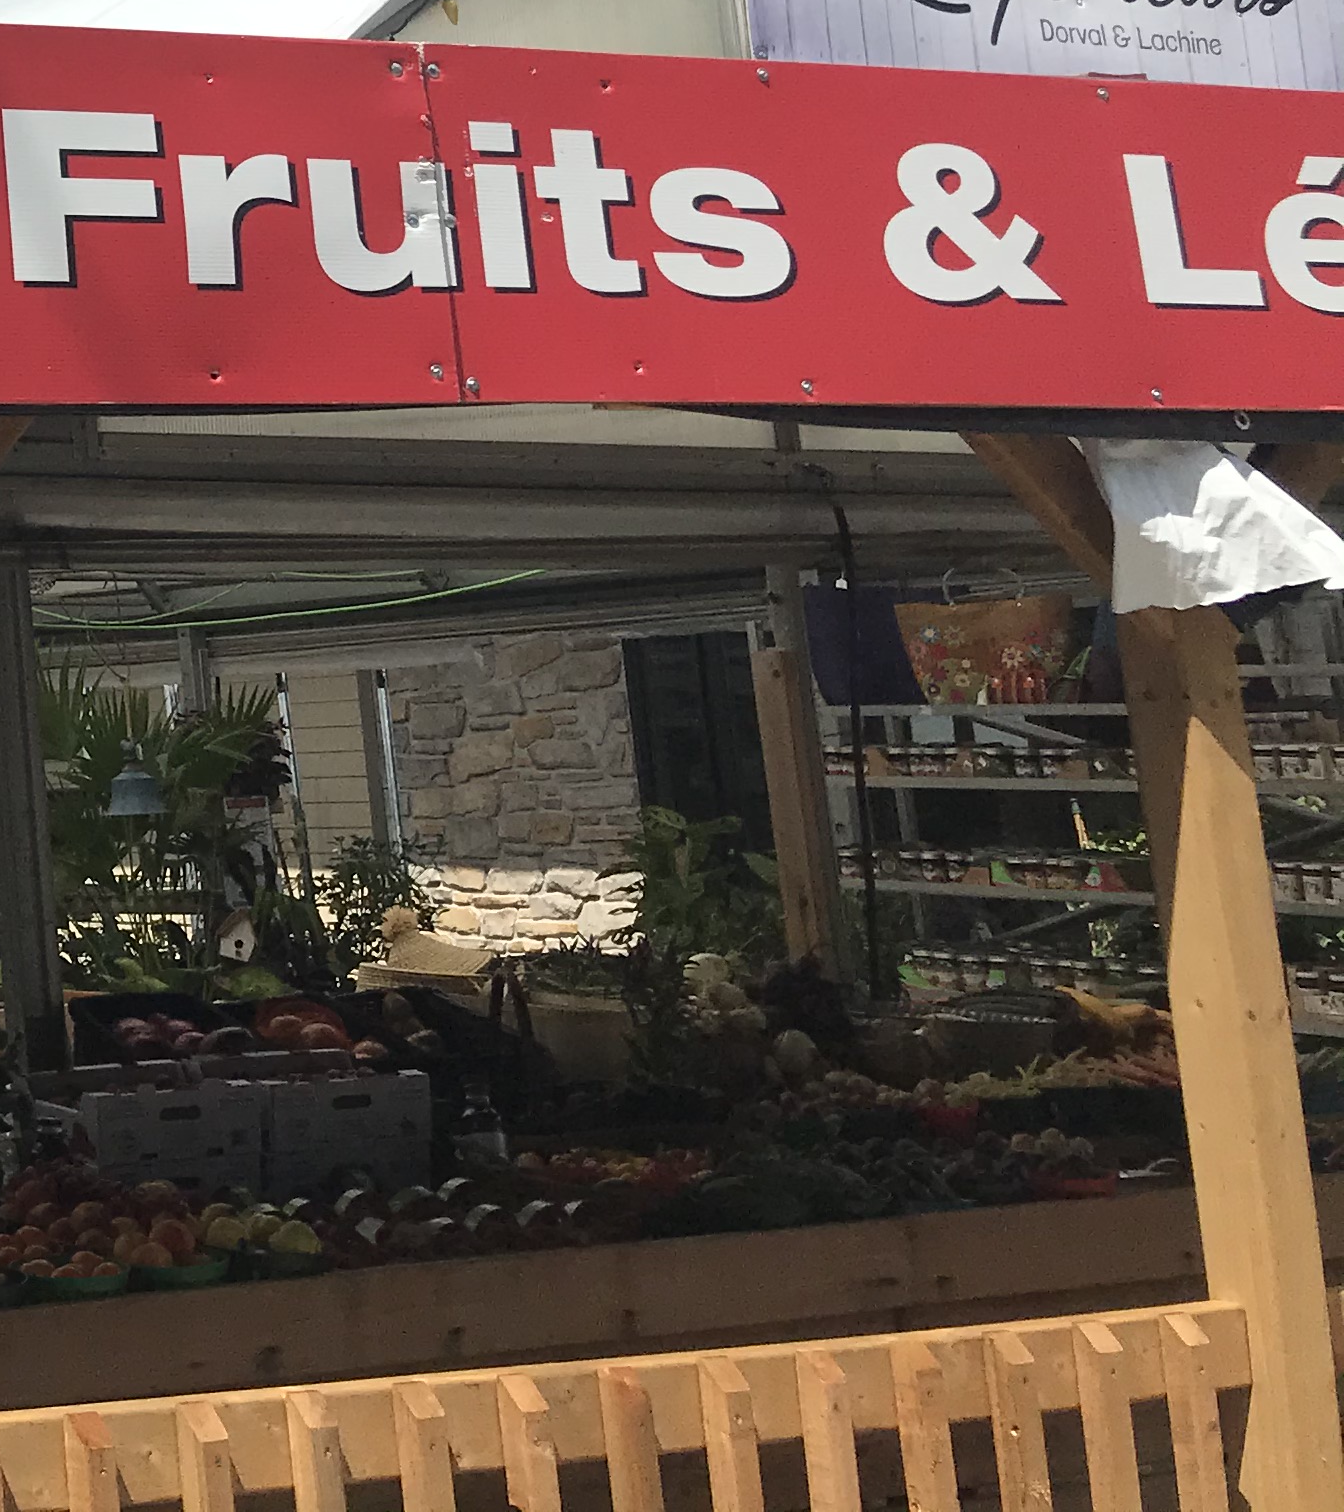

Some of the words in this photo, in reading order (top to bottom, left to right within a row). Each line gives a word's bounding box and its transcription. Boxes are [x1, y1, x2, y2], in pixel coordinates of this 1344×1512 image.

[1040, 18, 1108, 48] Dorval
[1113, 27, 1131, 48] &
[1137, 26, 1223, 56] Lachine
[1, 108, 795, 302] Fruits
[883, 142, 1068, 306] &
